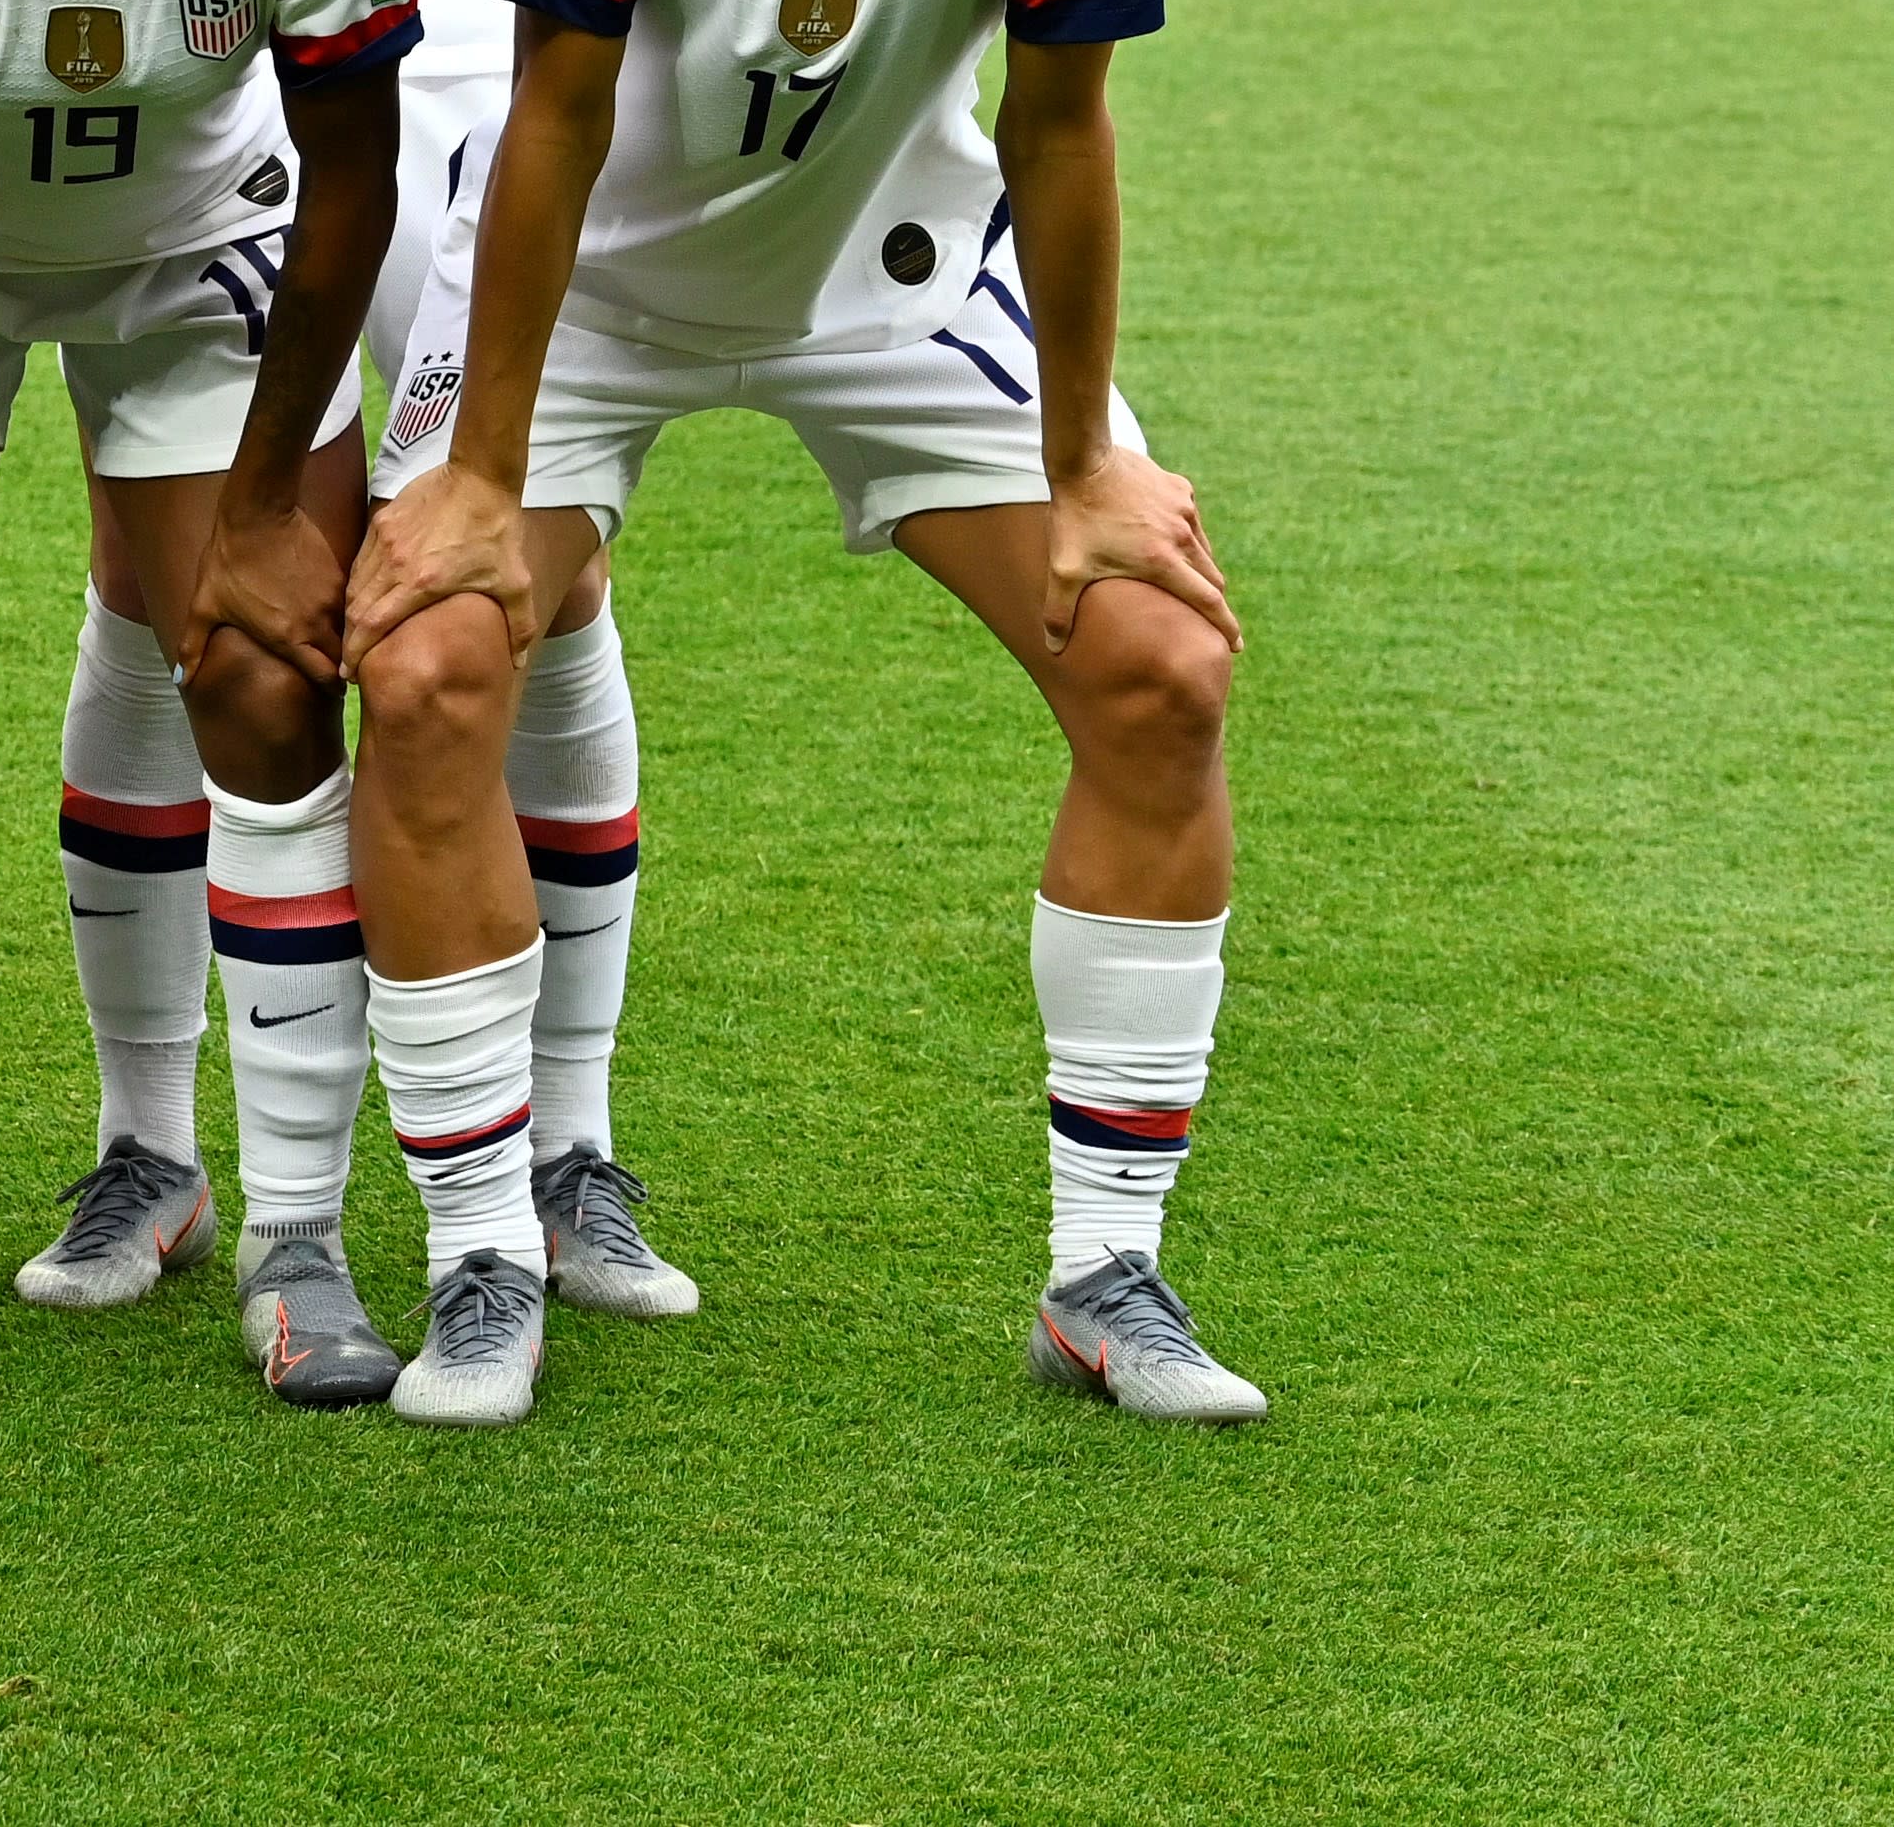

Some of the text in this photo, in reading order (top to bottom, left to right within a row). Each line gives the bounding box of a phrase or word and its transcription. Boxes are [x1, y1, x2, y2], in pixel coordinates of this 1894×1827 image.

[797, 22, 831, 33] FIFA
[66, 61, 101, 72] FIFA
[739, 61, 849, 161] 17
[24, 105, 139, 185] 19
[410, 371, 463, 400] USA
